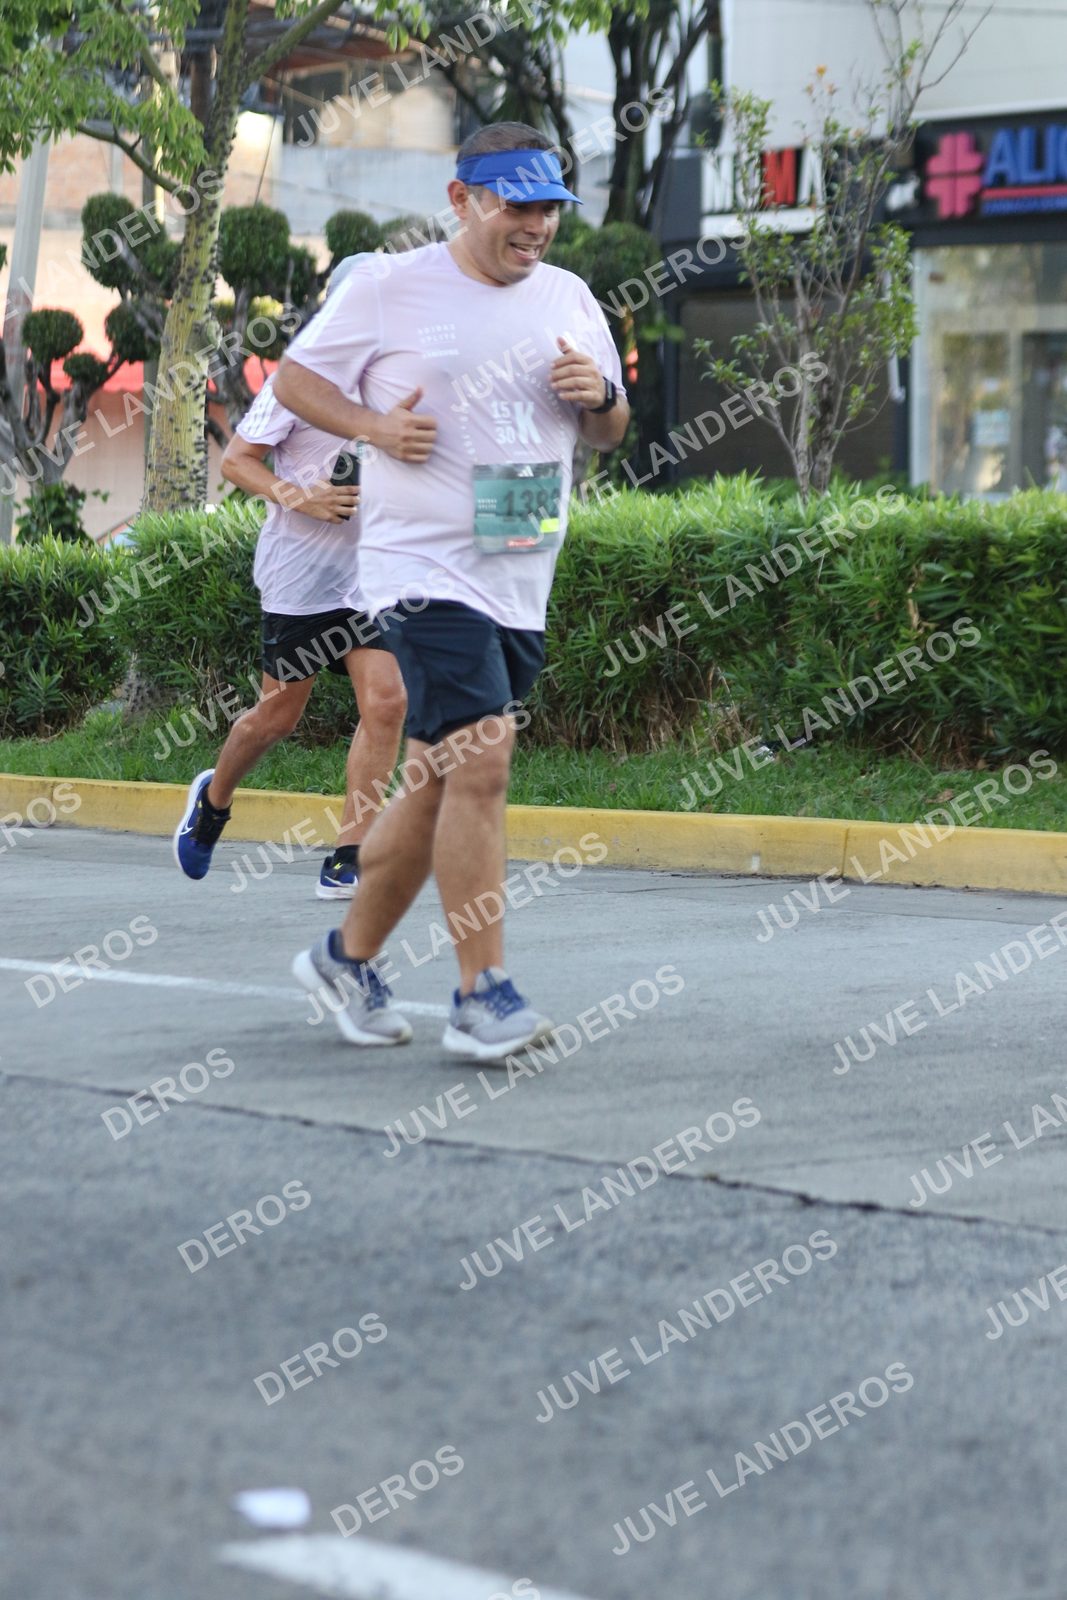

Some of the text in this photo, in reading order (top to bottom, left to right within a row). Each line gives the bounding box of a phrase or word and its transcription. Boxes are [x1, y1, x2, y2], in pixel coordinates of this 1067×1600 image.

[981, 124, 1067, 187] ALI
[491, 400, 511, 418] 15
[513, 400, 543, 445] K
[495, 425, 516, 445] 30
